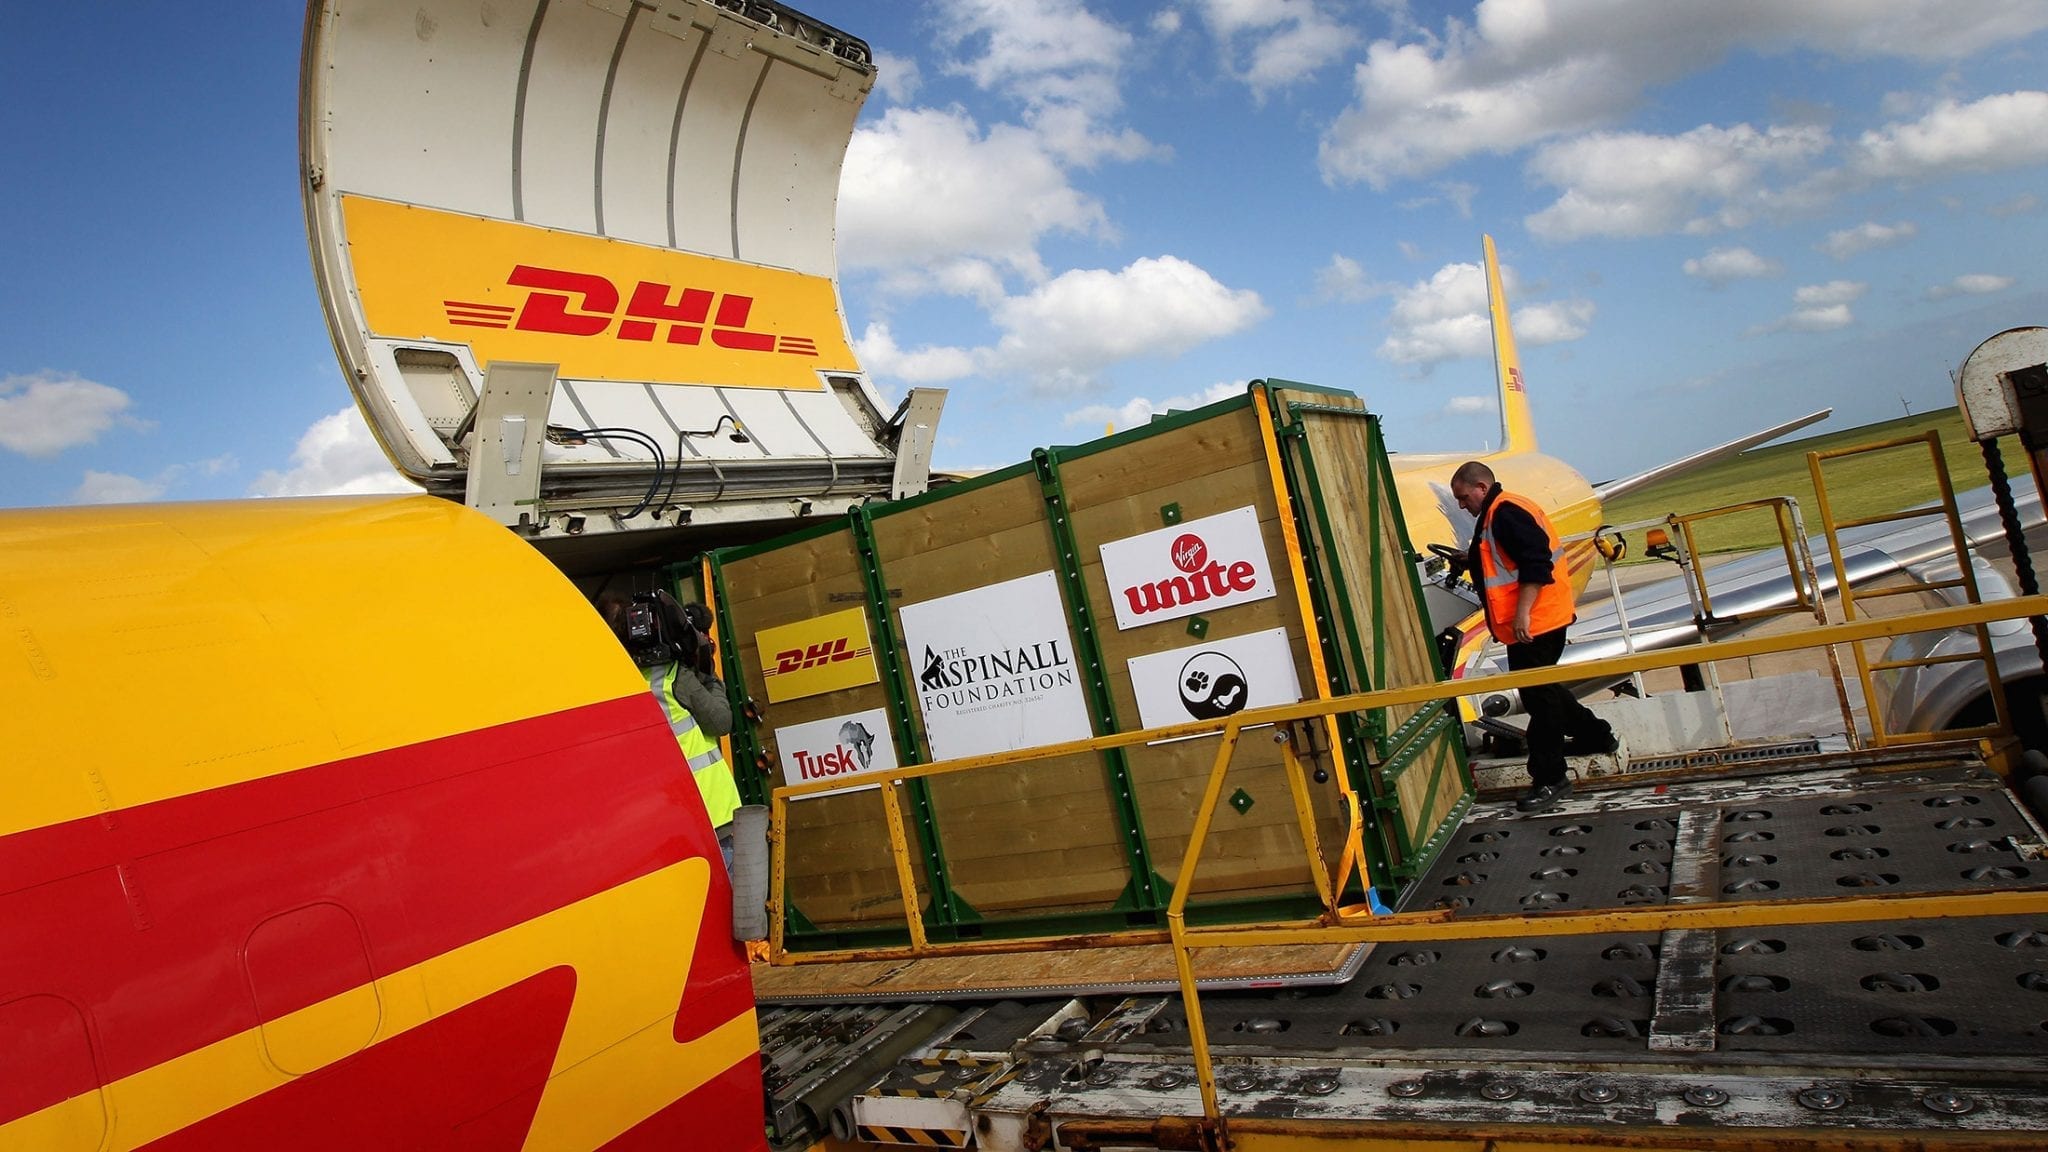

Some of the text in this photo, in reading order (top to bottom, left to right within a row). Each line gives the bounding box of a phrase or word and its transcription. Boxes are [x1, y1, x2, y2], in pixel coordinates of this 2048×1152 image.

[506, 264, 777, 353] DHL
[1175, 541, 1203, 569] Virgin
[1124, 559, 1257, 615] unite
[775, 636, 858, 675] DHL
[920, 639, 1069, 692] ASPINALL
[943, 646, 968, 661] THE
[924, 669, 1074, 713] FOUNDATION
[792, 744, 859, 780] Tusk
